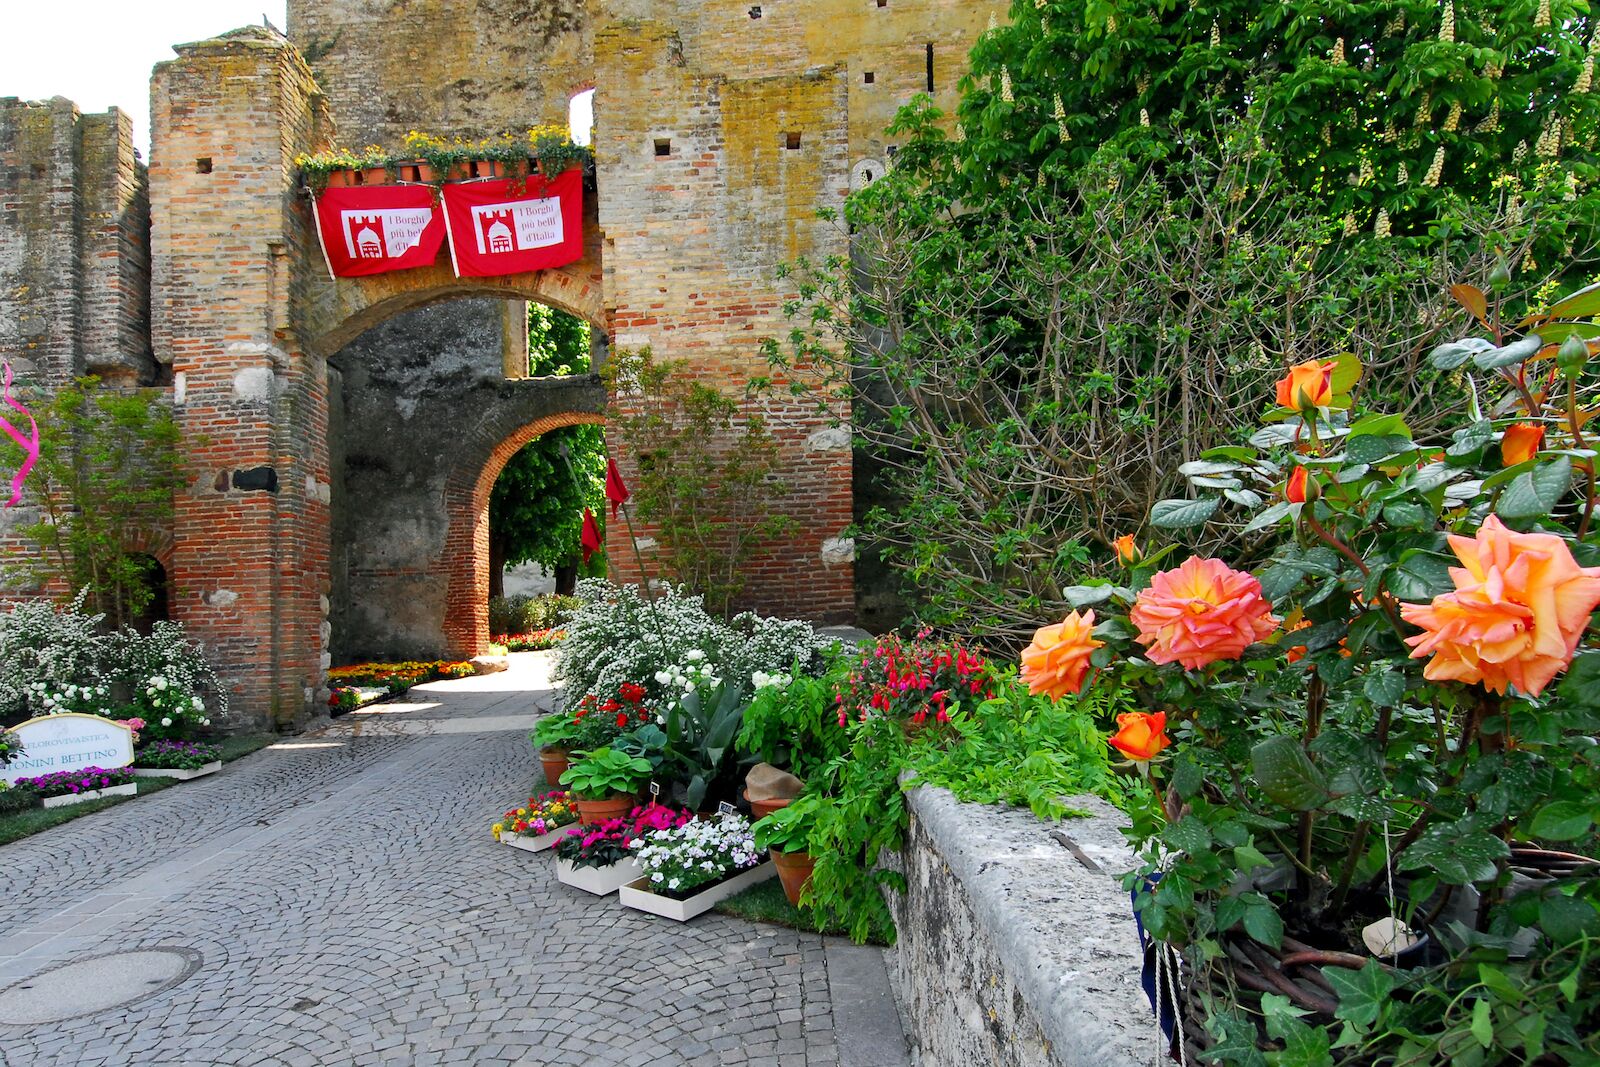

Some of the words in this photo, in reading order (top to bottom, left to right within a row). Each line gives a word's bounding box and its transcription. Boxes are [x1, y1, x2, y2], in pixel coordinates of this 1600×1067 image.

[526, 205, 554, 215] Borghi
[396, 215, 425, 225] Borghi
[521, 221, 535, 231] più
[537, 217, 556, 227] belli
[391, 229, 405, 239] più
[526, 232, 555, 242] d'Italia
[61, 748, 118, 764] BETTINO
